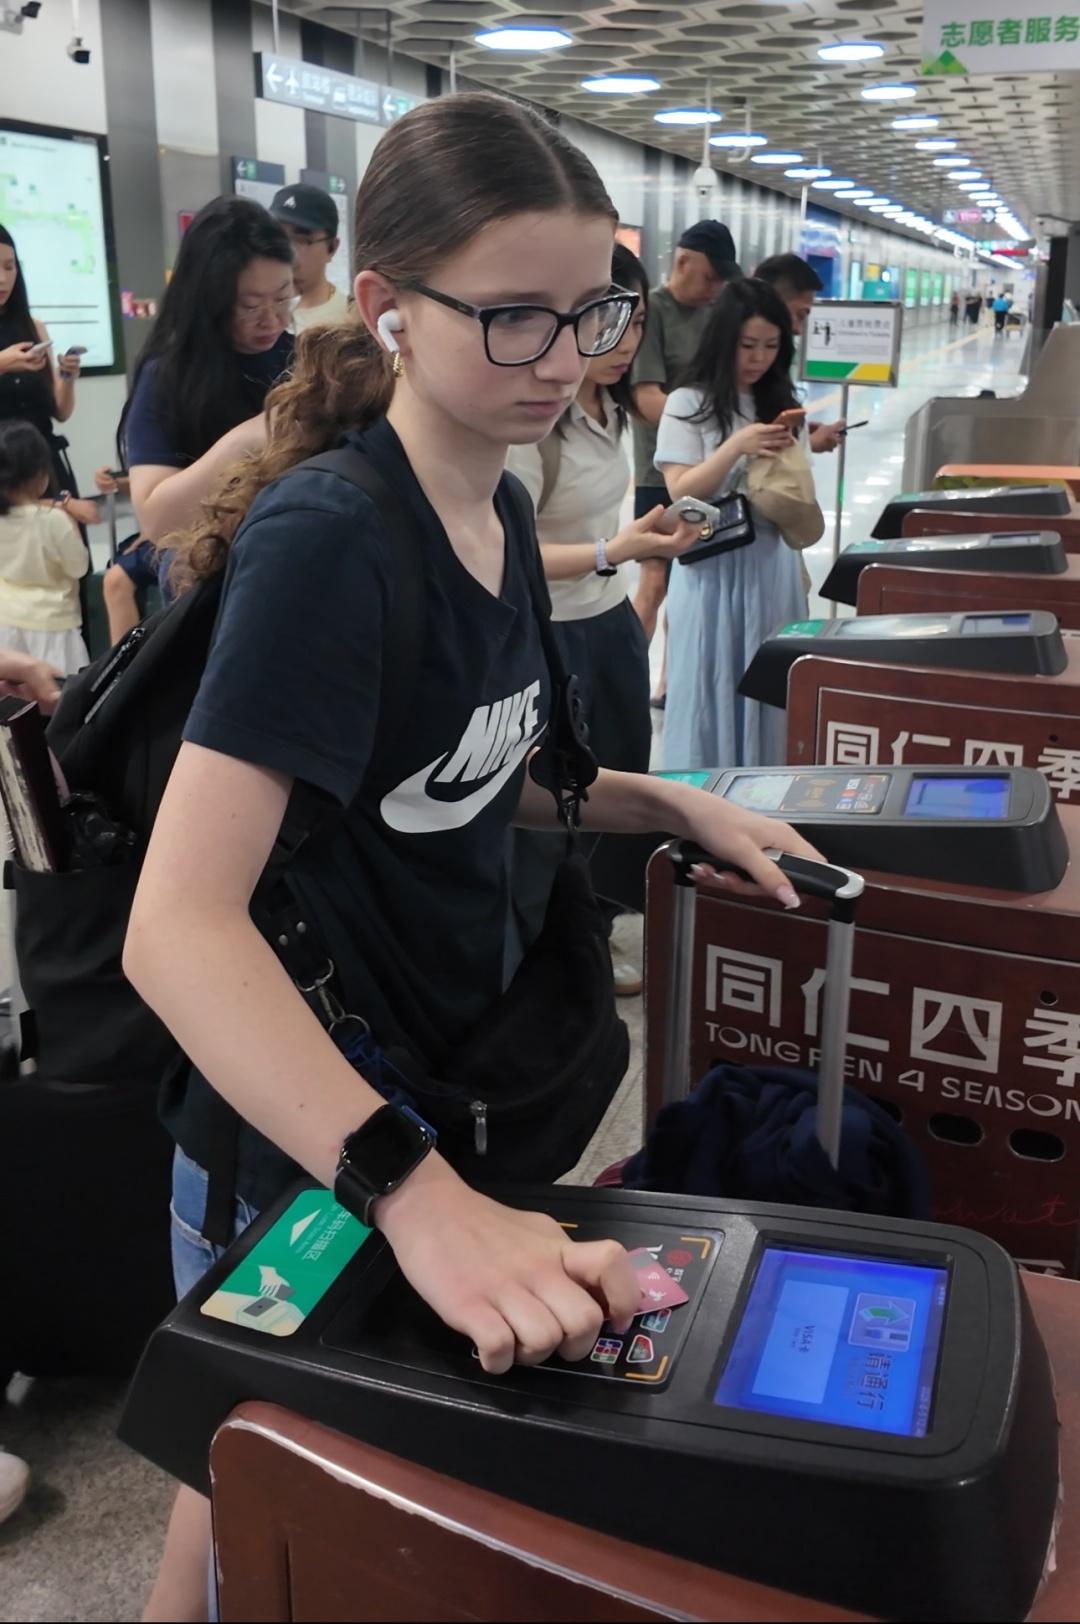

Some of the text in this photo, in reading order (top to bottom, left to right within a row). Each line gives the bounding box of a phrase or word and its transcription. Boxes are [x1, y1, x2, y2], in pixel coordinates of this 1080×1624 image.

[940, 15, 1080, 48] 志愿者服务
[433, 679, 541, 783] NIKE
[705, 943, 1080, 1088] 同仁四季
[705, 1022, 800, 1063] TONG
[898, 1069, 925, 1093] 4
[856, 1351, 892, 1411] 请通行
